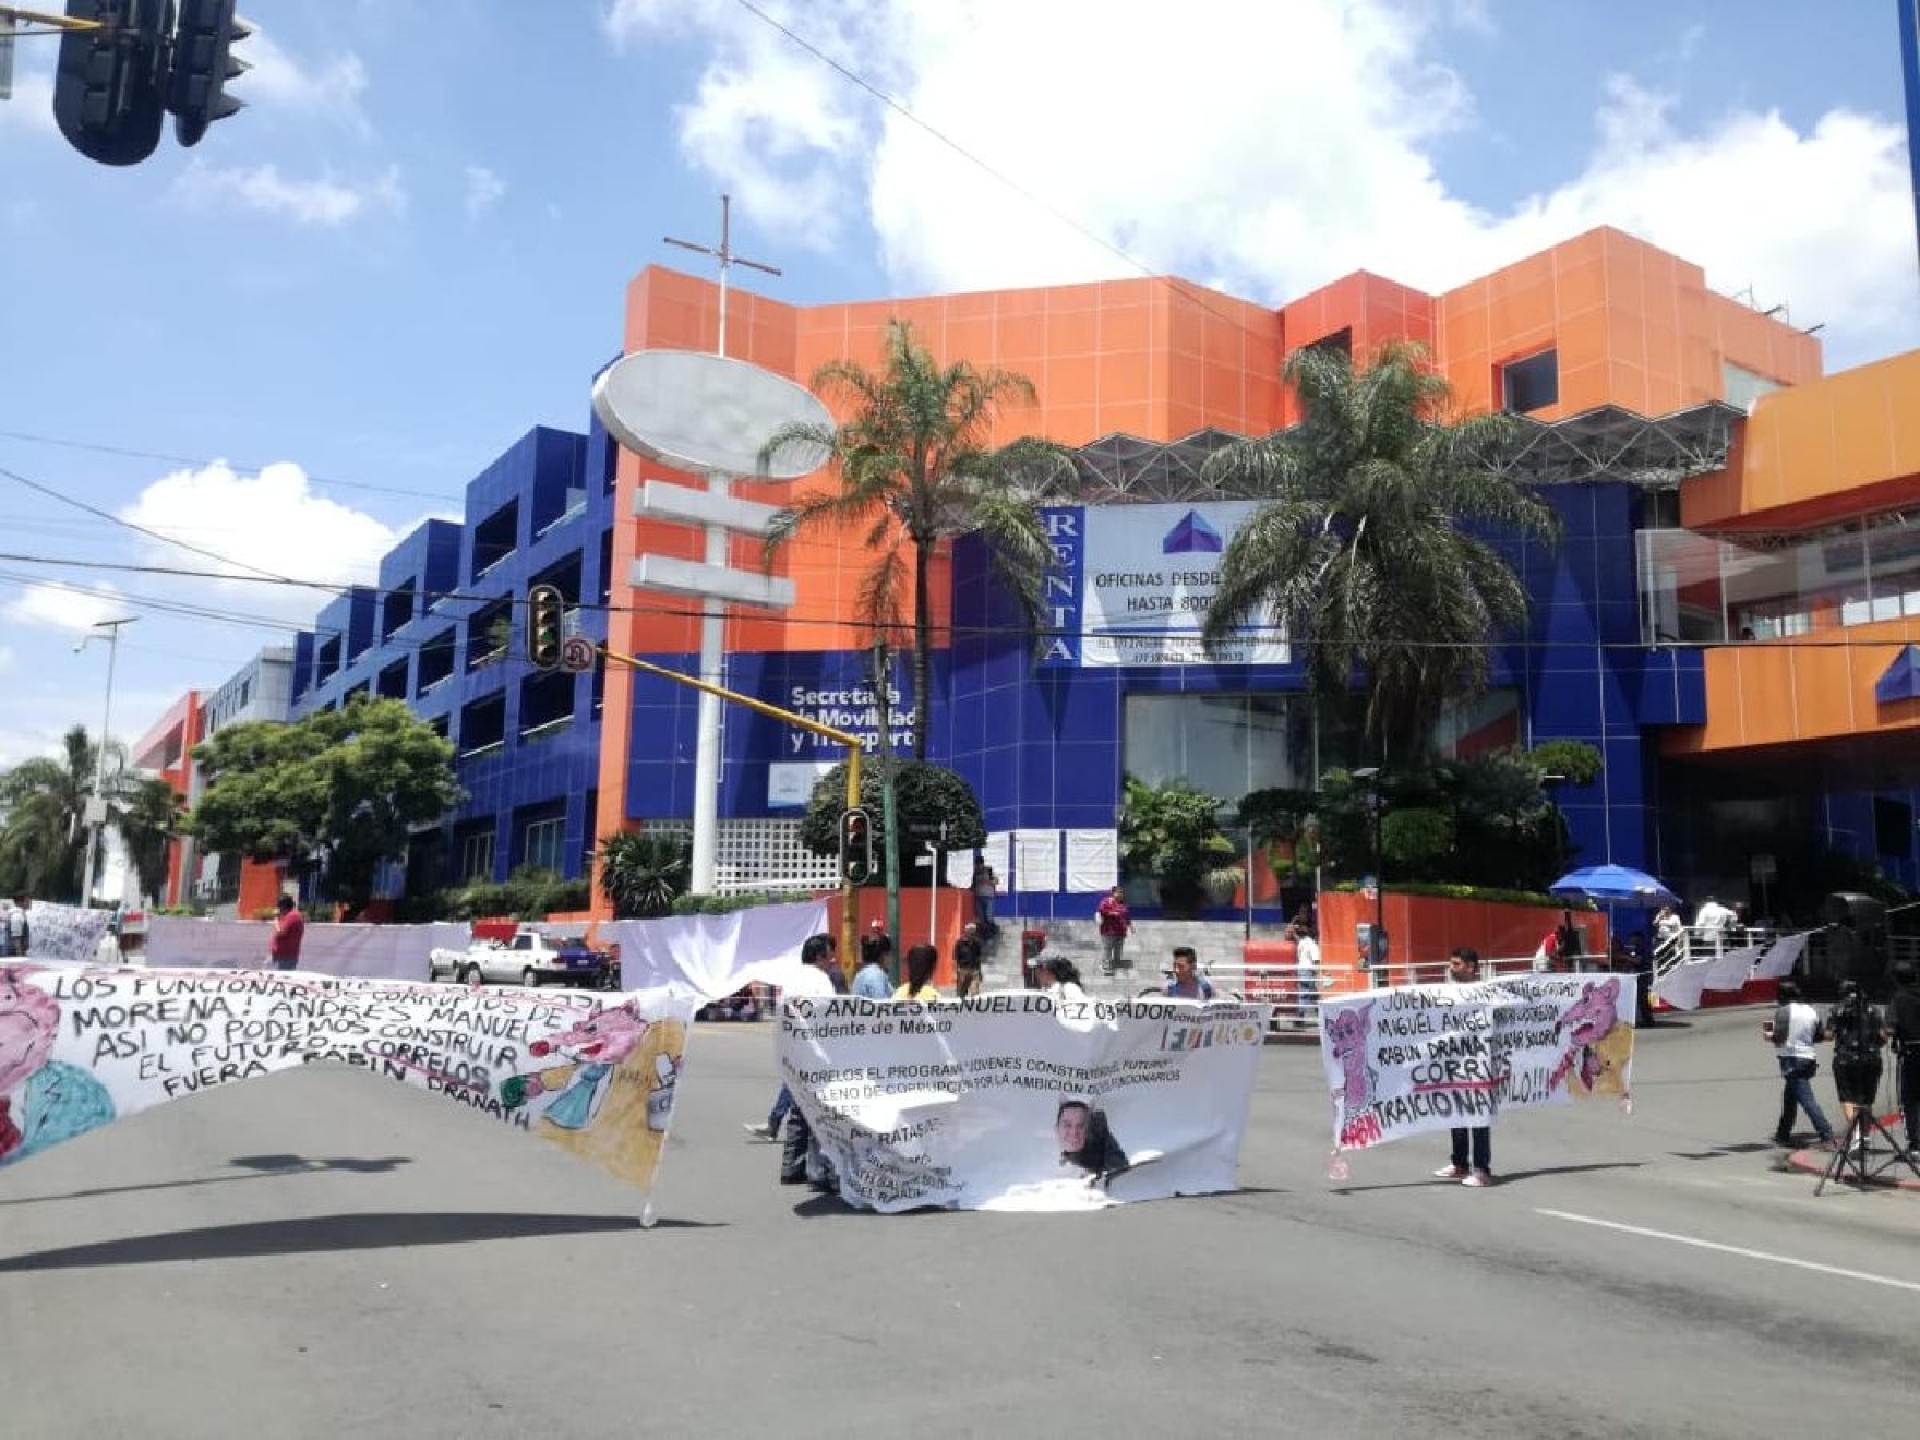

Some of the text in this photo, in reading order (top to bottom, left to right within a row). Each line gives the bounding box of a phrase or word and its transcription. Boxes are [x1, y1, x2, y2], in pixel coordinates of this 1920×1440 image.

[1044, 514, 1079, 660] RENTA
[1095, 571, 1221, 588] OFICINAS DESDE
[1127, 596, 1174, 612] HASTA
[791, 733, 804, 753] y
[55, 976, 117, 1000] LOS
[527, 1003, 565, 1029] DE
[269, 999, 412, 1022] ANDRES
[427, 1007, 529, 1046] MANUEL
[93, 1018, 518, 1075] ASI NO PODEMOS CONSTRUIR
[871, 1020, 894, 1035] de
[139, 1054, 172, 1081] EL
[362, 1039, 492, 1094] CORRELOS
[799, 1067, 864, 1085] MORELOS
[866, 1066, 886, 1080] EL
[163, 1060, 269, 1097] FUERA
[427, 1075, 531, 1131] DRANATH
